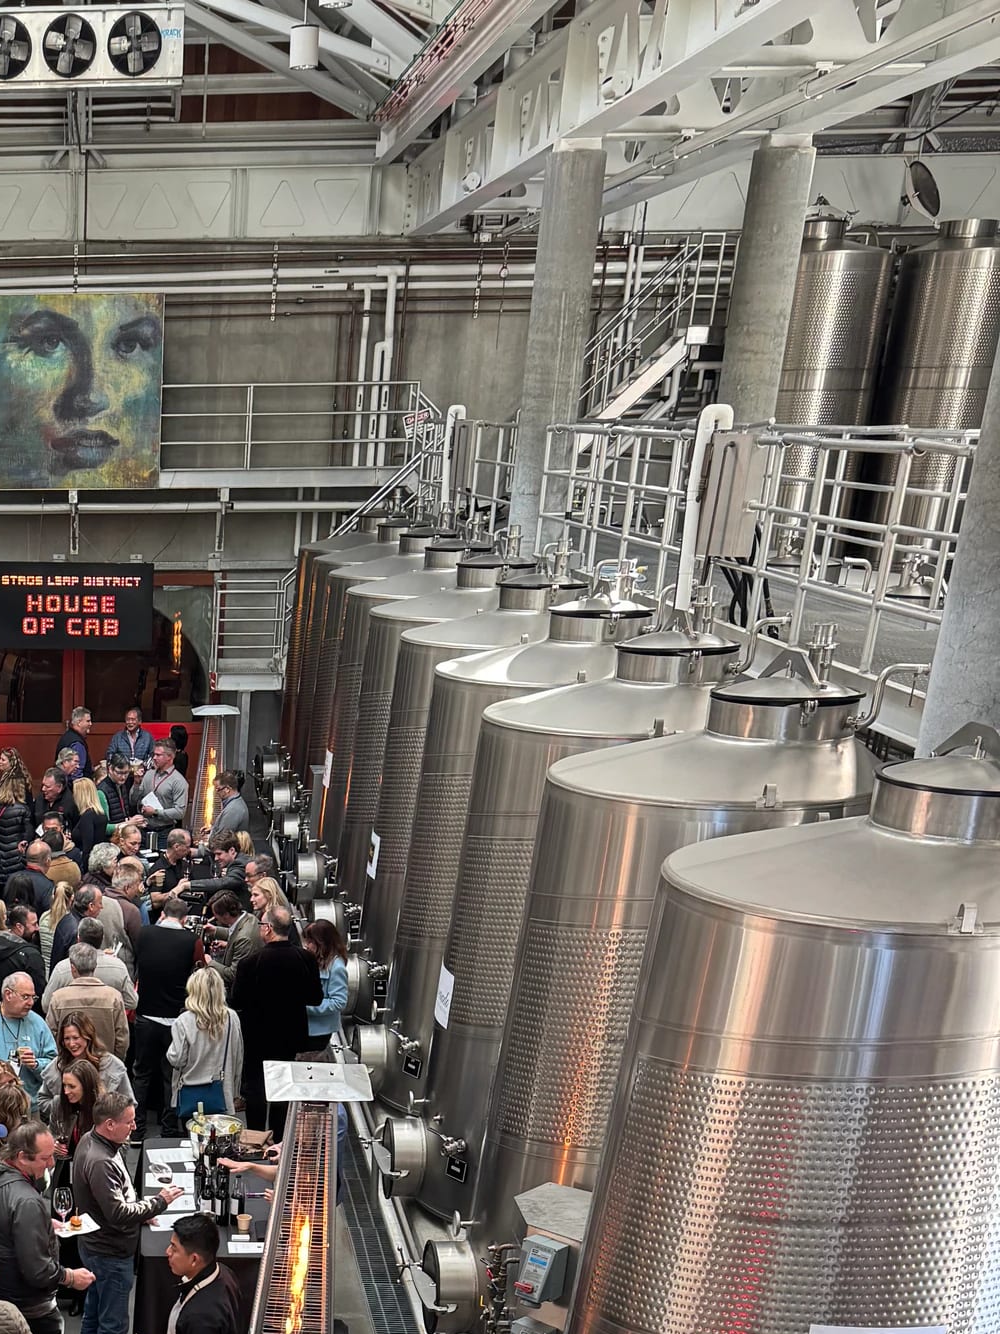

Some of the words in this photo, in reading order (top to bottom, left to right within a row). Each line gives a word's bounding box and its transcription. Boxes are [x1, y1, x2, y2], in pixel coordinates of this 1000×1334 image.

[1, 575, 43, 585] STAGS
[47, 576, 79, 586] LEAP
[83, 576, 141, 587] DISTRICT
[26, 594, 116, 614] HOUSE
[22, 617, 55, 635] OF
[65, 617, 120, 636] CAB
